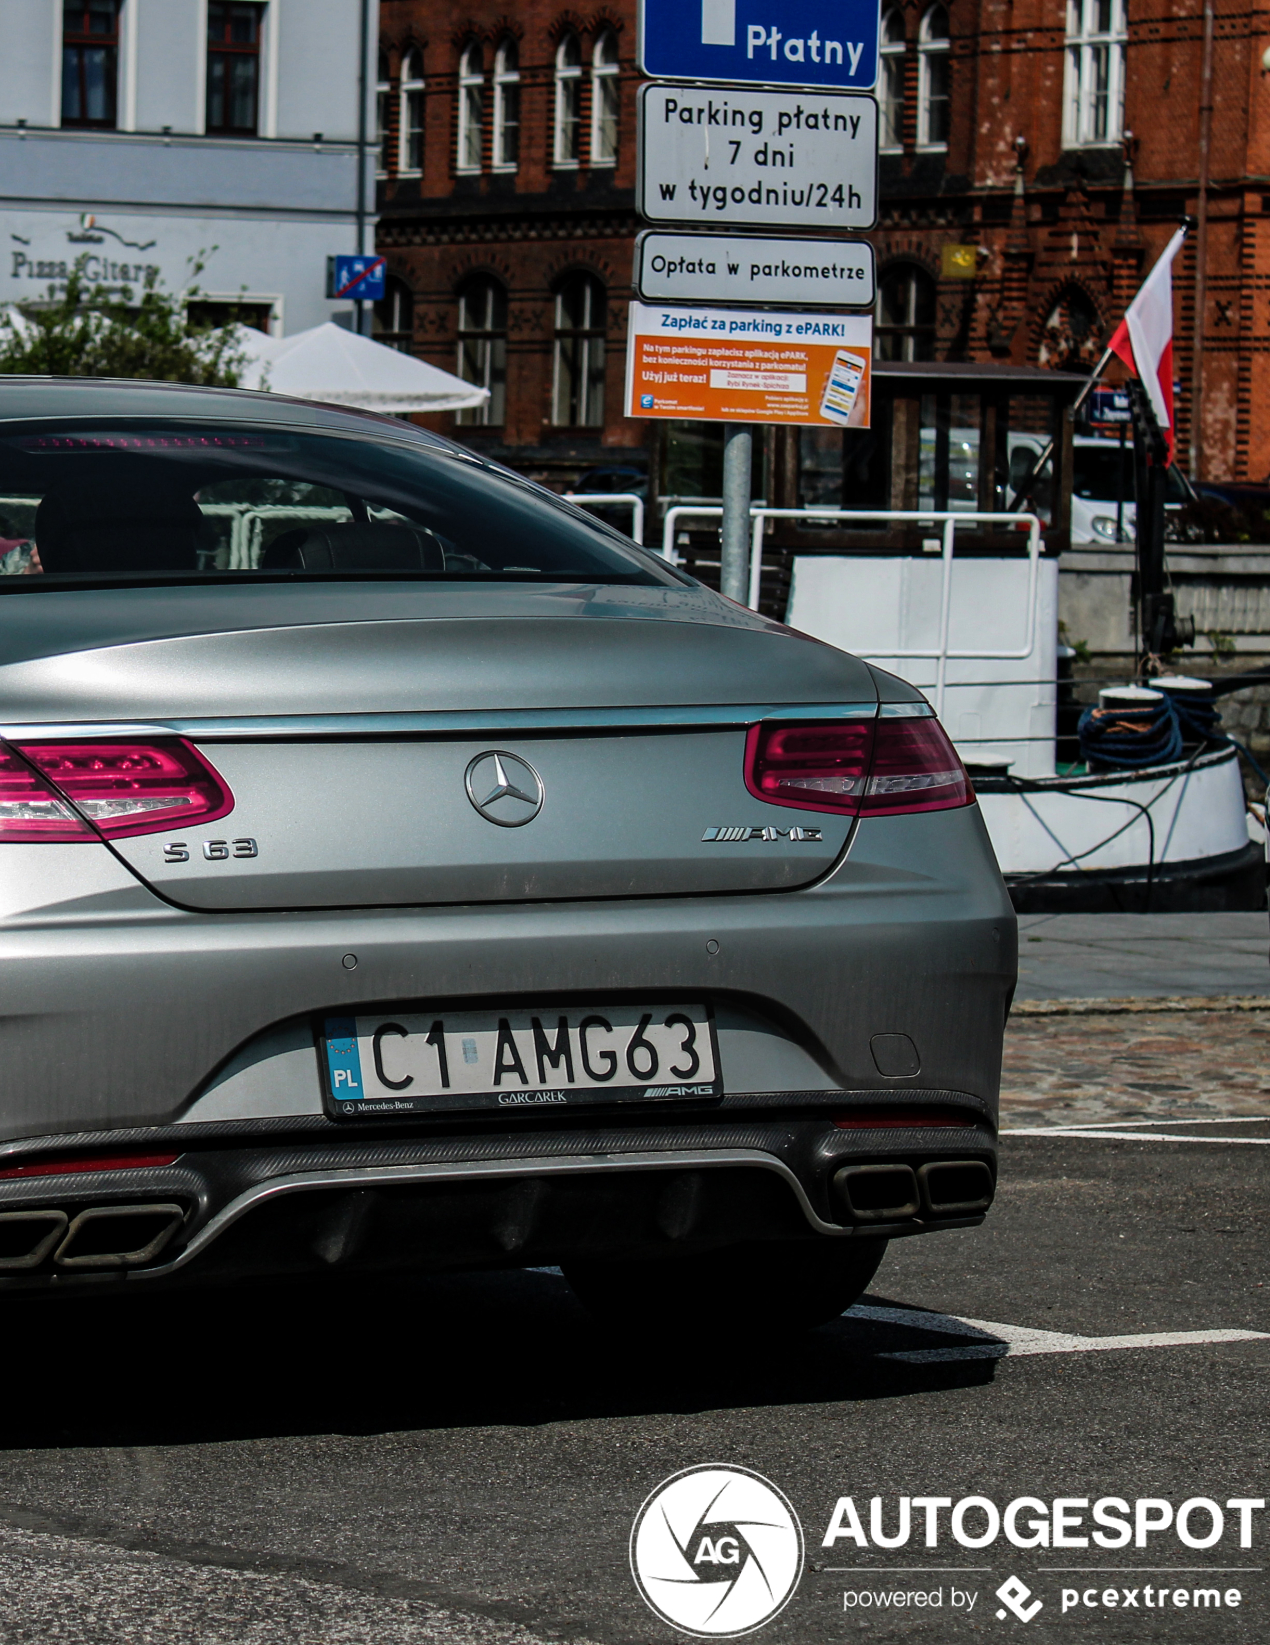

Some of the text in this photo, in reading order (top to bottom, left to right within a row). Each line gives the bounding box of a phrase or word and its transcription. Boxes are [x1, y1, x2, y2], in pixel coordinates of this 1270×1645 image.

[747, 24, 864, 76] Płatny
[664, 98, 861, 140] Parking płatny
[728, 140, 795, 168] 7 dni
[659, 179, 862, 211] w tygodniu/24h
[10, 251, 68, 278] Pizza
[651, 255, 865, 282] Opłata w parkometrze
[661, 314, 846, 337] Zapłać za parking z ePARK!
[643, 344, 654, 352] Na
[655, 345, 671, 354] tym
[672, 345, 707, 357] parkingu
[642, 354, 657, 364] bez
[658, 355, 708, 366] konieczności
[709, 358, 755, 369] korzystania
[760, 361, 807, 371] parkomatu!
[641, 370, 707, 384] Użyj już teraz!
[727, 380, 740, 388] Rybi
[741, 826, 823, 841] AMG
[163, 837, 259, 863] S 63
[371, 1013, 702, 1092] C1 AMG63
[333, 1069, 359, 1089] PL
[497, 1090, 567, 1105] GARCAREK
[665, 1085, 714, 1096] AMG
[357, 1101, 414, 1112] Mercedes-Benz
